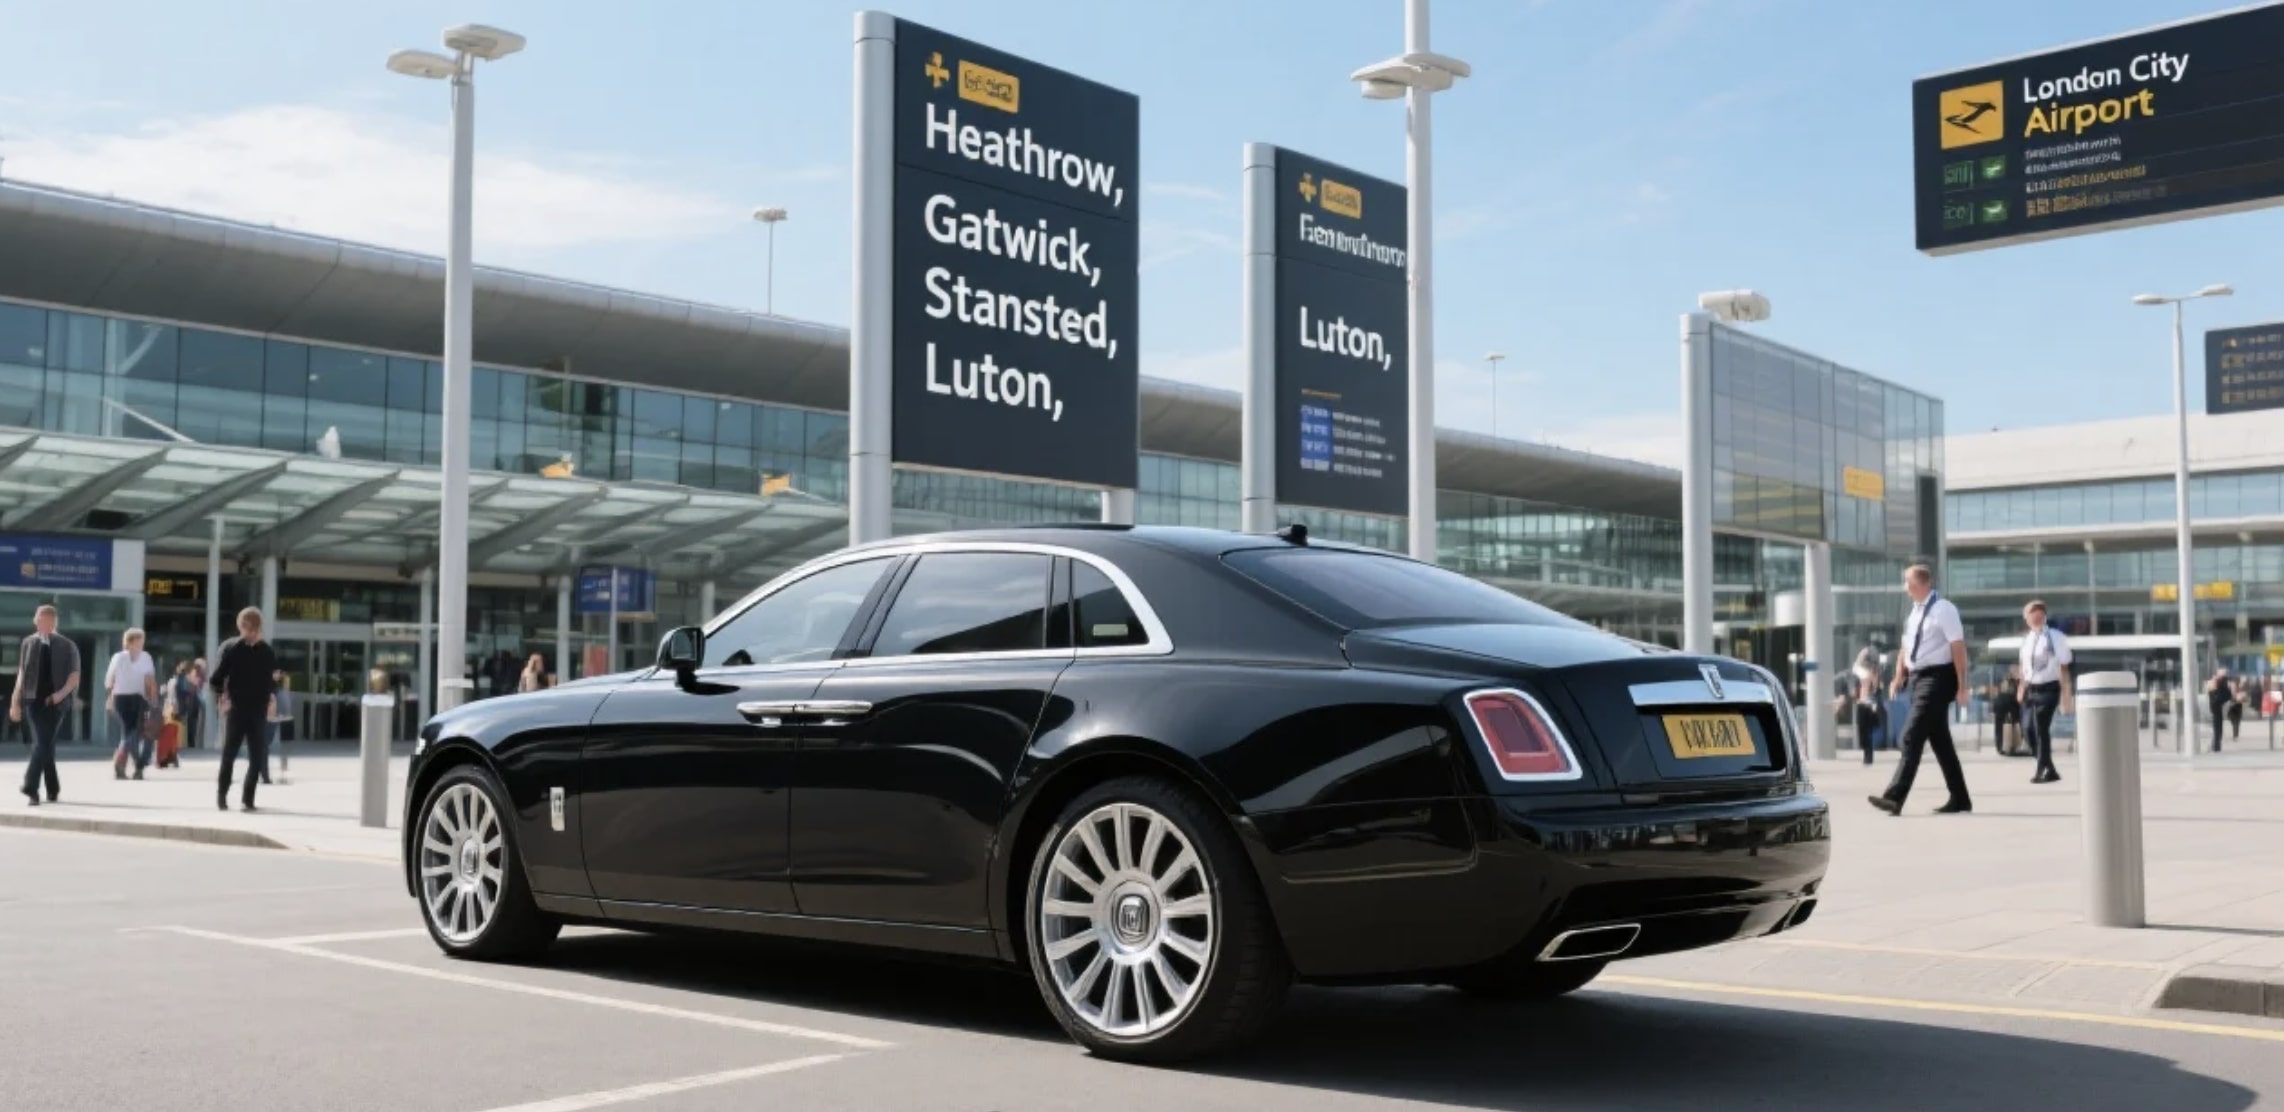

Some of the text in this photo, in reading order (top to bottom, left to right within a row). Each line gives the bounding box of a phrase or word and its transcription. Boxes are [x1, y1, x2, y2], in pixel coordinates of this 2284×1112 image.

[2129, 52, 2189, 82] City
[2024, 89, 2154, 138] Airport
[926, 102, 1124, 208] Heathrow,
[924, 193, 1101, 288] Gatwick,
[924, 266, 1118, 360] Stansted,
[1300, 305, 1392, 372] Luton,
[926, 341, 1064, 422] Luton,
